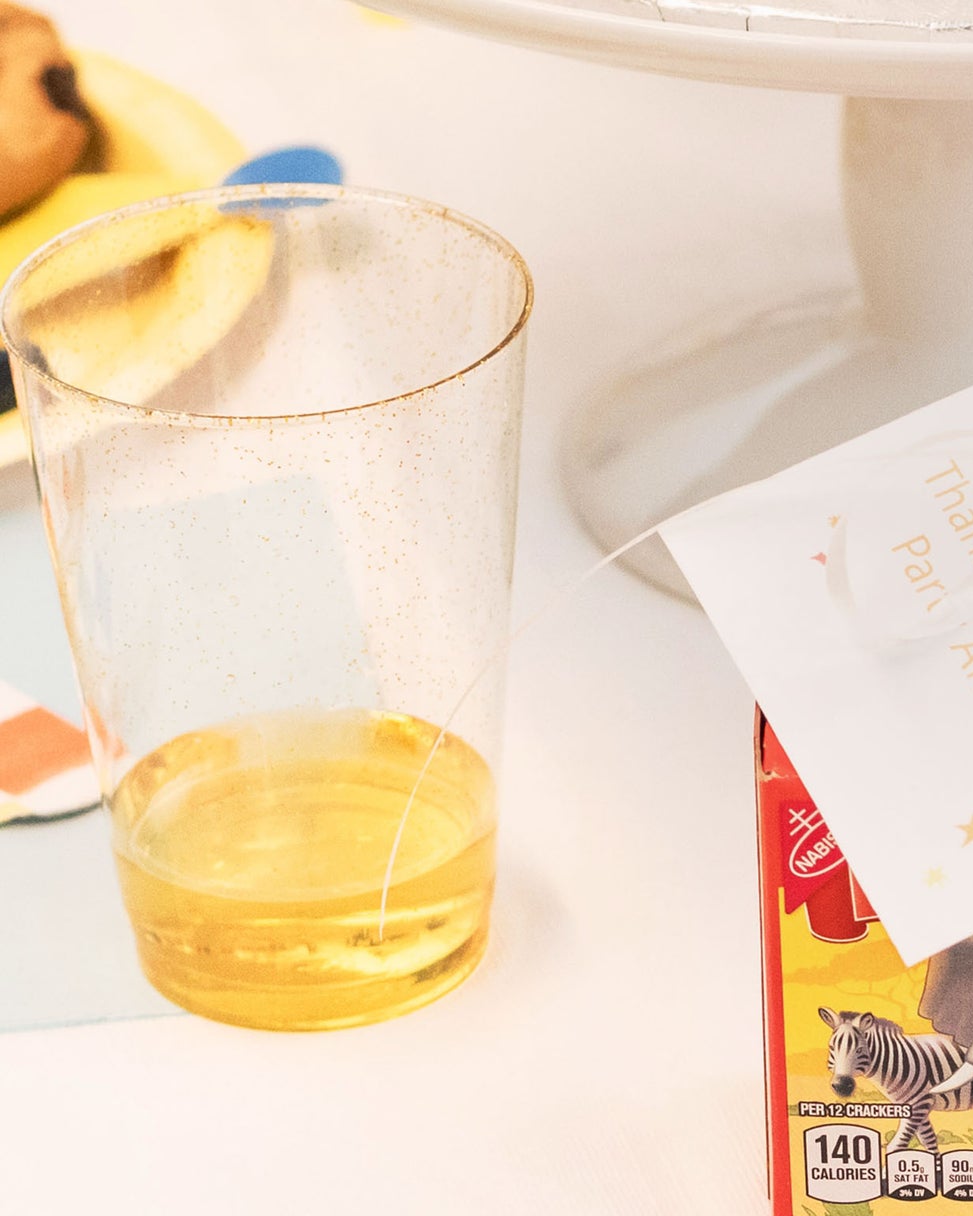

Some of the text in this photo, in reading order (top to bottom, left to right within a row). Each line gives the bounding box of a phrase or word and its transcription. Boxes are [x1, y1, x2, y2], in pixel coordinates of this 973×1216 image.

[800, 1102, 912, 1118] PER 12 CRACKERS
[814, 1134, 872, 1165] 140
[811, 1167, 877, 1181] CALORIES
[894, 1174, 929, 1183] SAT FAT
